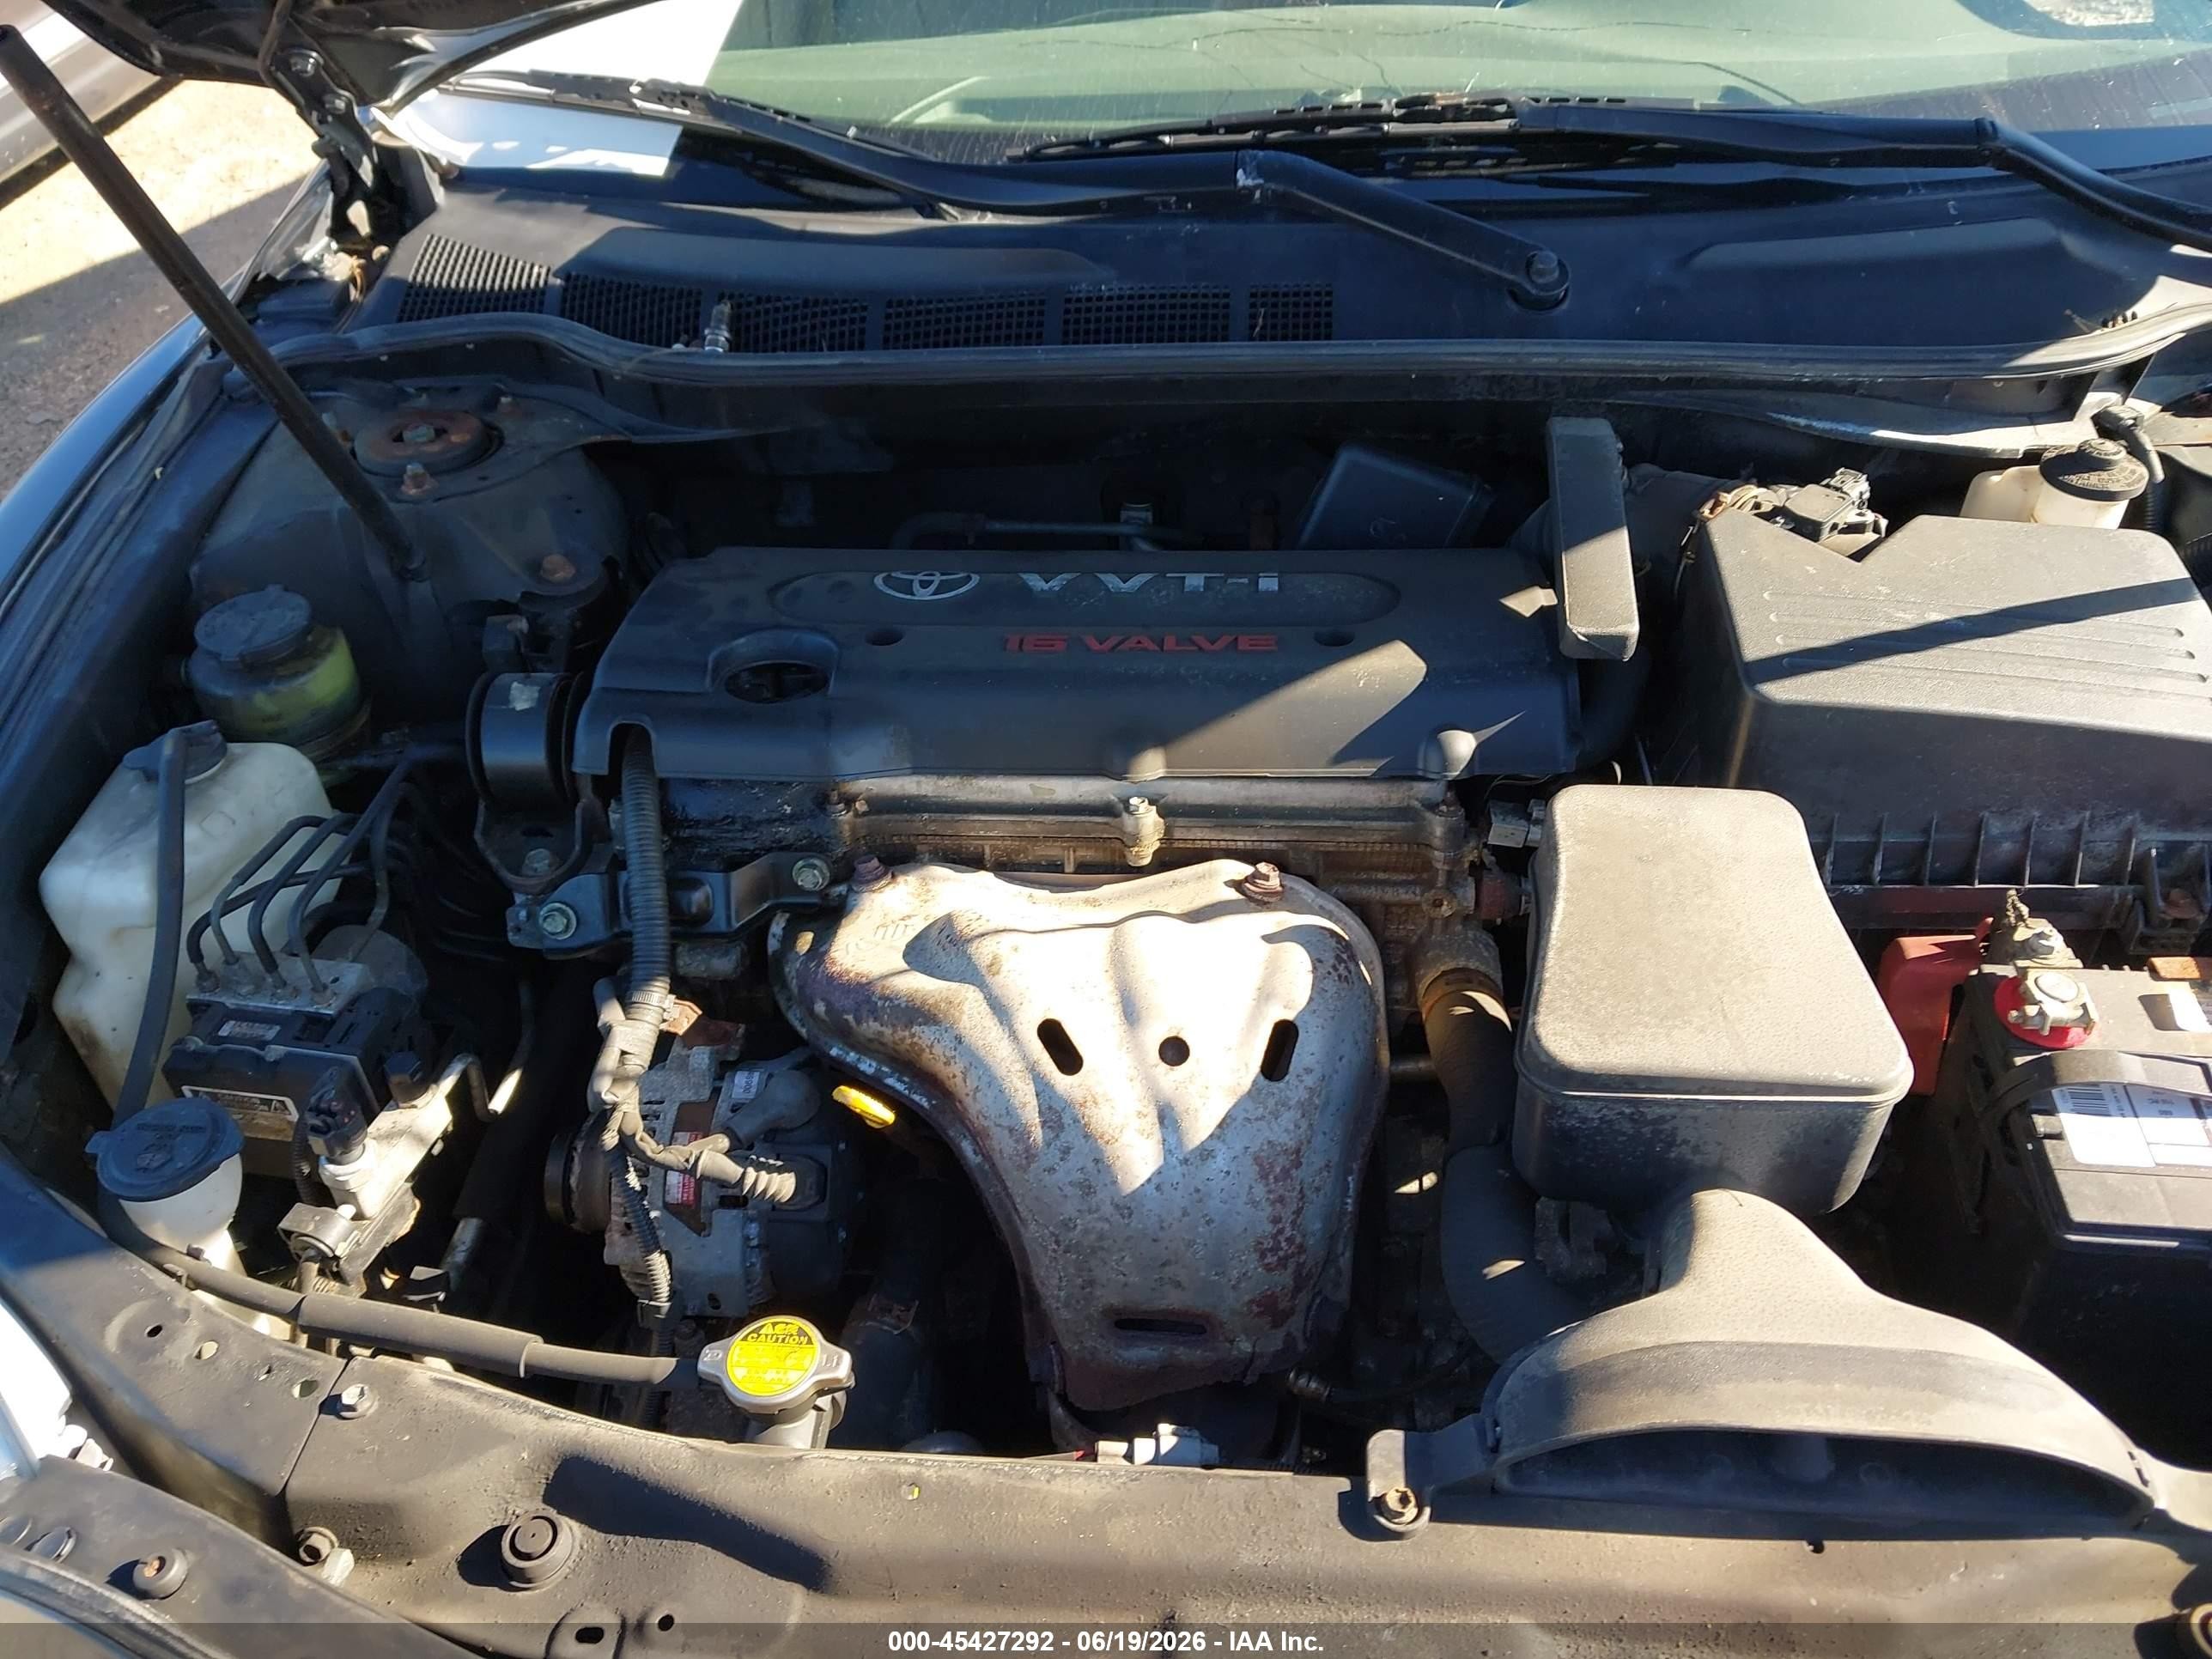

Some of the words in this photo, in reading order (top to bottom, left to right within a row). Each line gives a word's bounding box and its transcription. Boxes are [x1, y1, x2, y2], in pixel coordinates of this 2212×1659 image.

[1005, 634, 1070, 653] 16
[1079, 634, 1278, 653] VALVE
[747, 1334, 808, 1345] CAUTION
